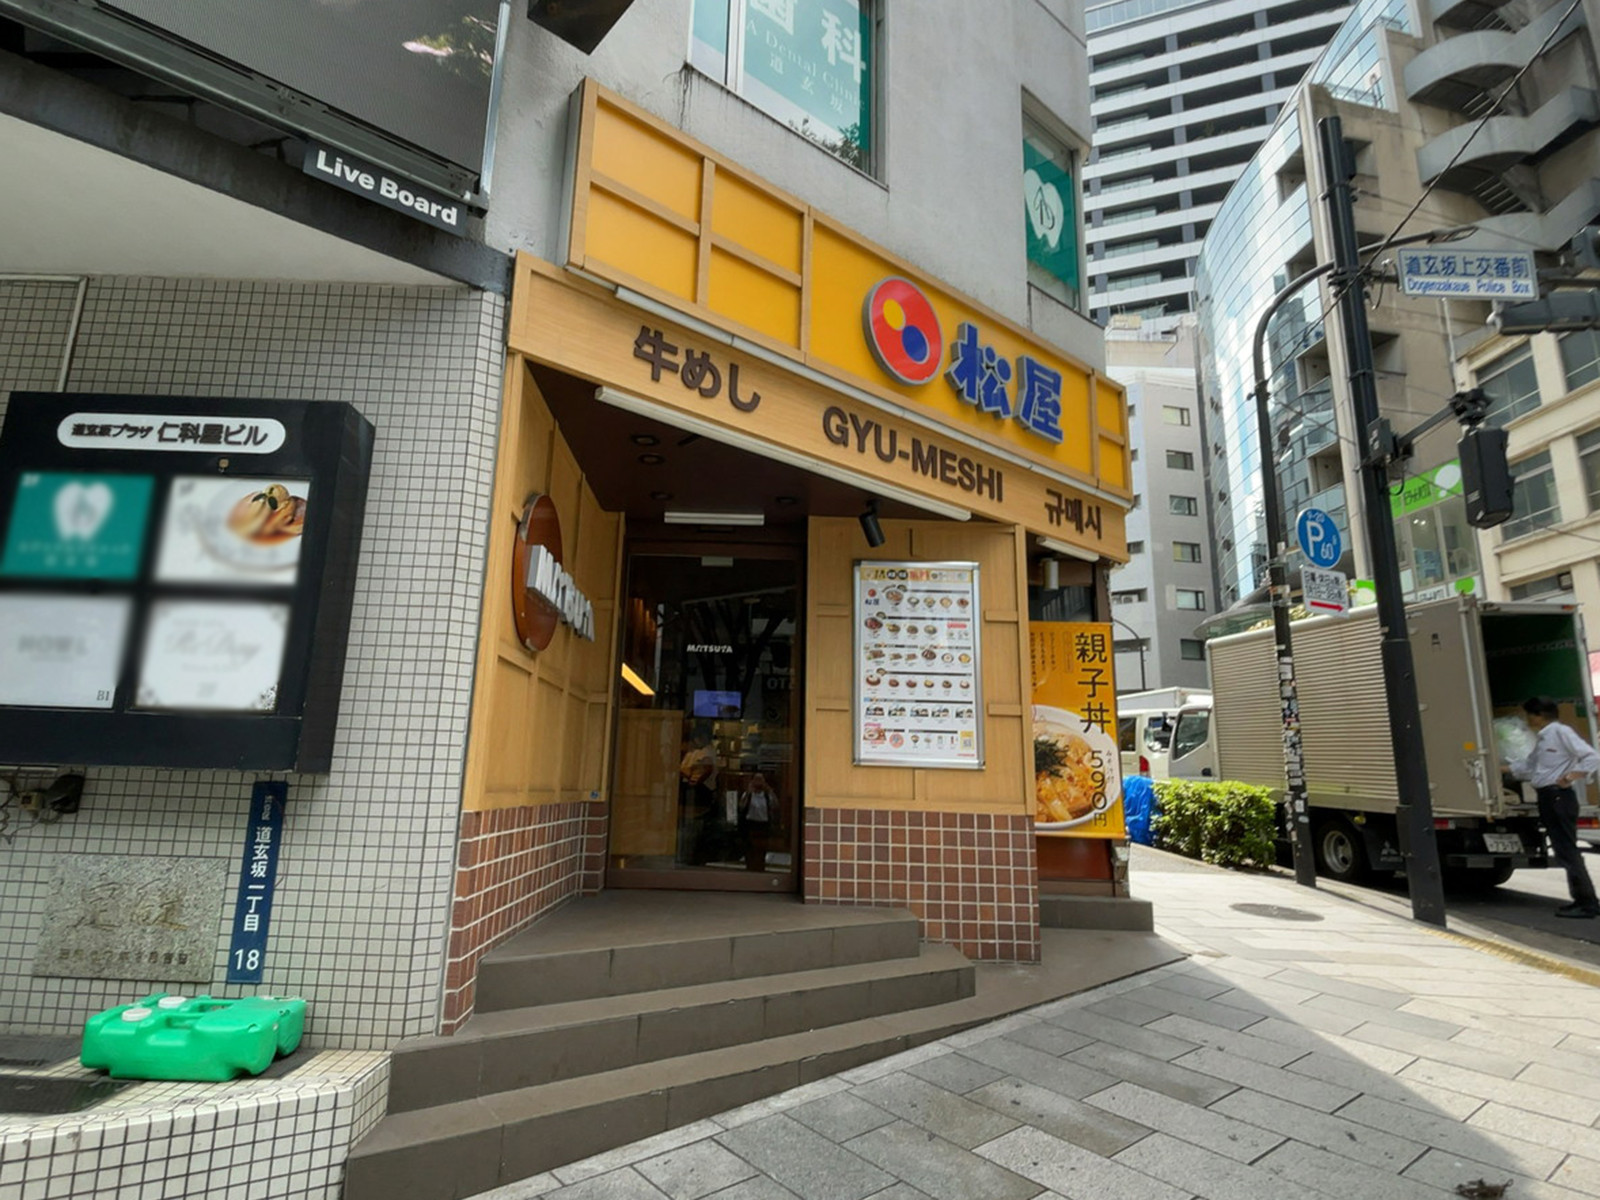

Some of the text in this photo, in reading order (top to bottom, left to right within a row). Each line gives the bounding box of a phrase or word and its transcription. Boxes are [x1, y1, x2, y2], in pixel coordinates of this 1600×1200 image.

[766, 30, 817, 77] Dental
[316, 150, 458, 226] Live Board
[633, 325, 762, 413] 牛めし
[945, 321, 1064, 443] 松屋
[822, 406, 1003, 502] GYU-MESHI
[1044, 488, 1102, 540] 규메시
[1306, 519, 1325, 558] P
[1075, 632, 1111, 734] 親子丼
[243, 826, 273, 932] 道玄坂一丁目
[234, 949, 260, 971] 18
